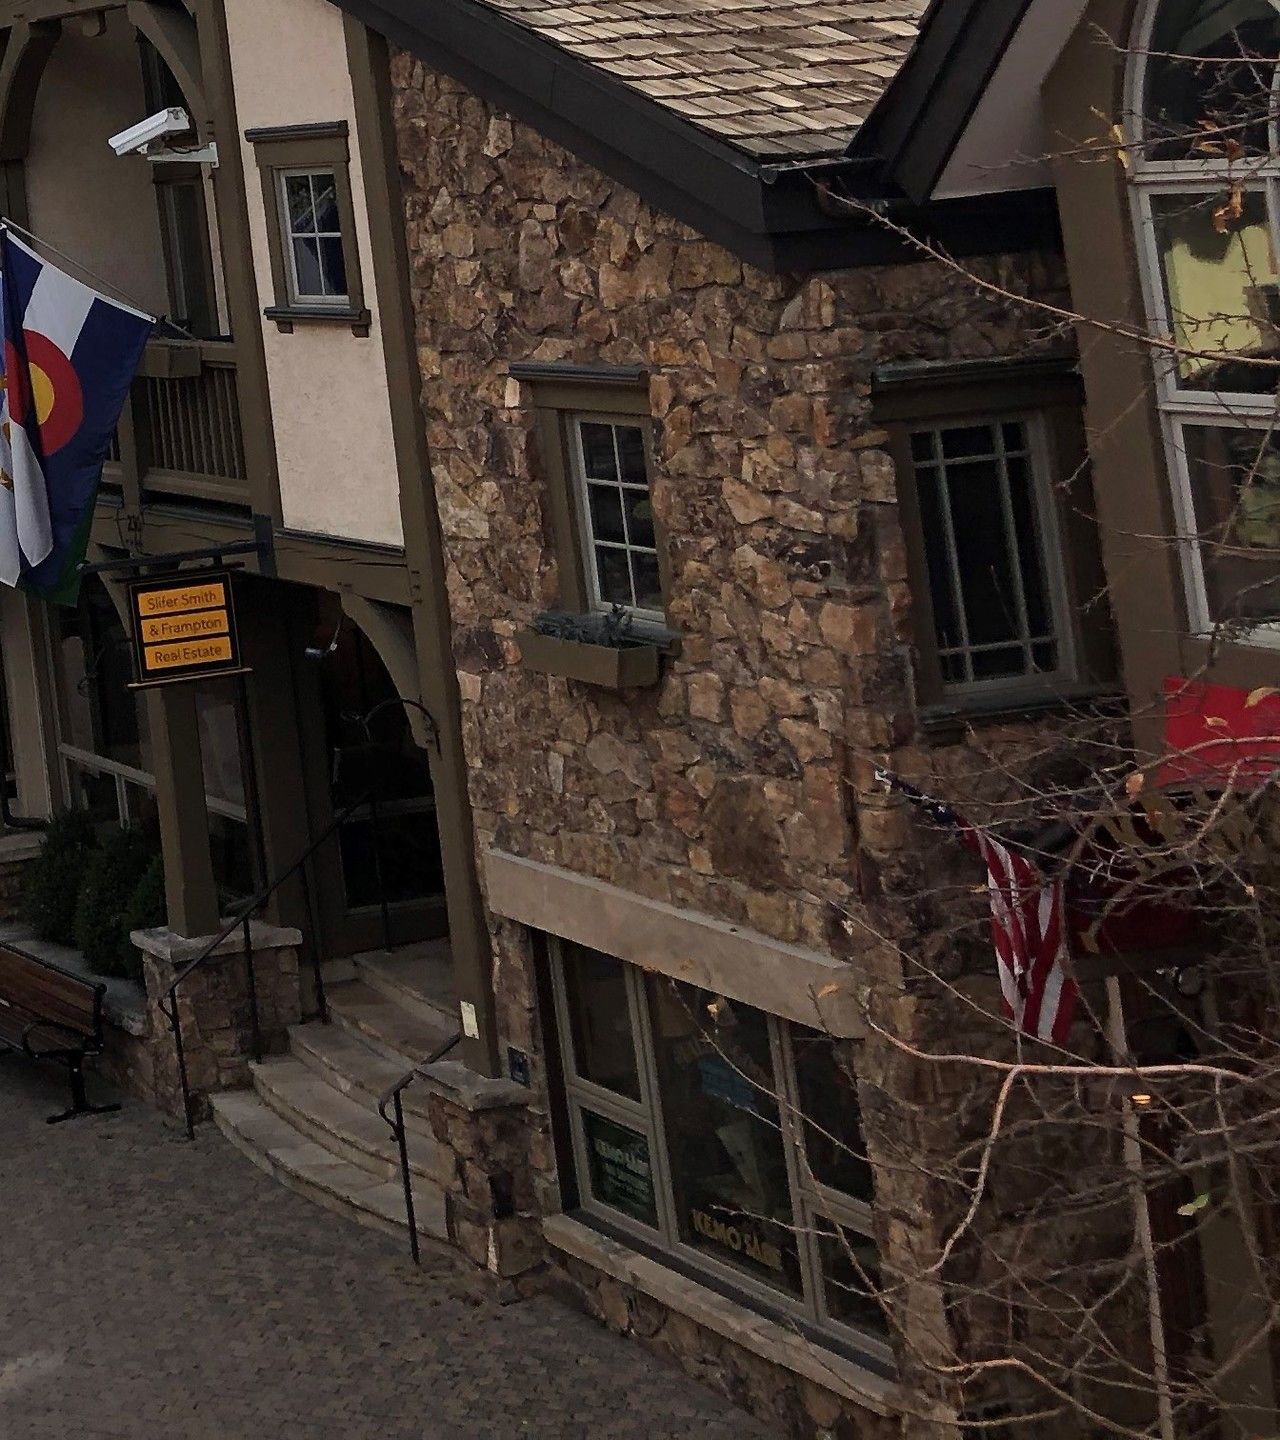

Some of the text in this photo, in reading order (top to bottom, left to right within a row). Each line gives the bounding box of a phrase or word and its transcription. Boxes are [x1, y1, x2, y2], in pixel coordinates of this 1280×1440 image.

[147, 590, 217, 610] Slifer Smith
[149, 618, 222, 637] & Frampton
[154, 645, 222, 664] Real Estate
